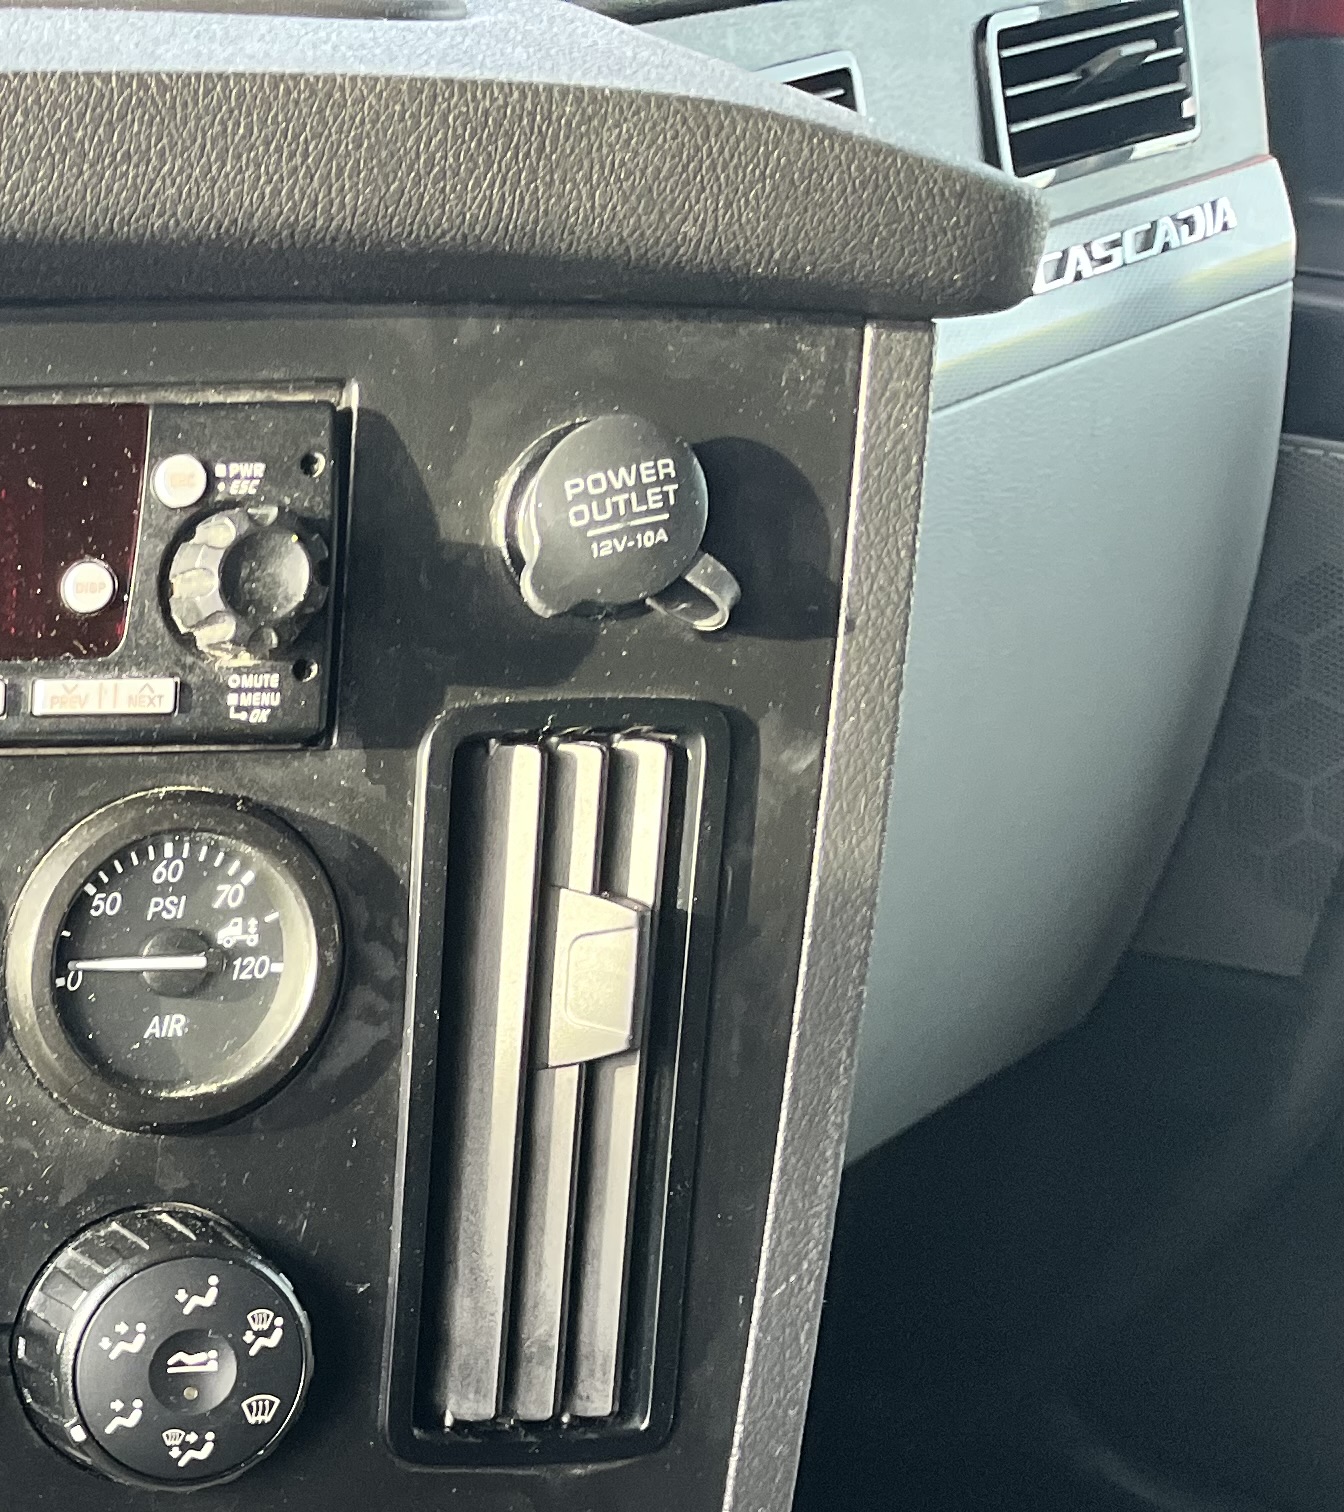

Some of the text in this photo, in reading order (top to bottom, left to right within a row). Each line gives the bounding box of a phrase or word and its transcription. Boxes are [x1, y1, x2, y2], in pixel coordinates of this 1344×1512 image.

[1032, 197, 1238, 295] CASCADIA
[228, 462, 266, 478] PWR
[564, 457, 677, 502] POWER
[229, 479, 261, 495] ESC
[568, 483, 679, 527] OUTLET
[590, 527, 669, 559] 12V-10A
[240, 673, 280, 688] MUTE
[49, 693, 88, 709] PREV
[127, 694, 164, 708] NEXT
[239, 692, 281, 707] MENU
[249, 708, 272, 723] OK
[152, 859, 184, 884] 60
[90, 891, 122, 917] 50
[146, 896, 187, 921] PSI
[213, 884, 245, 909] 70
[66, 969, 83, 992] 0
[232, 956, 270, 981] 120
[143, 1014, 186, 1039] AIR
